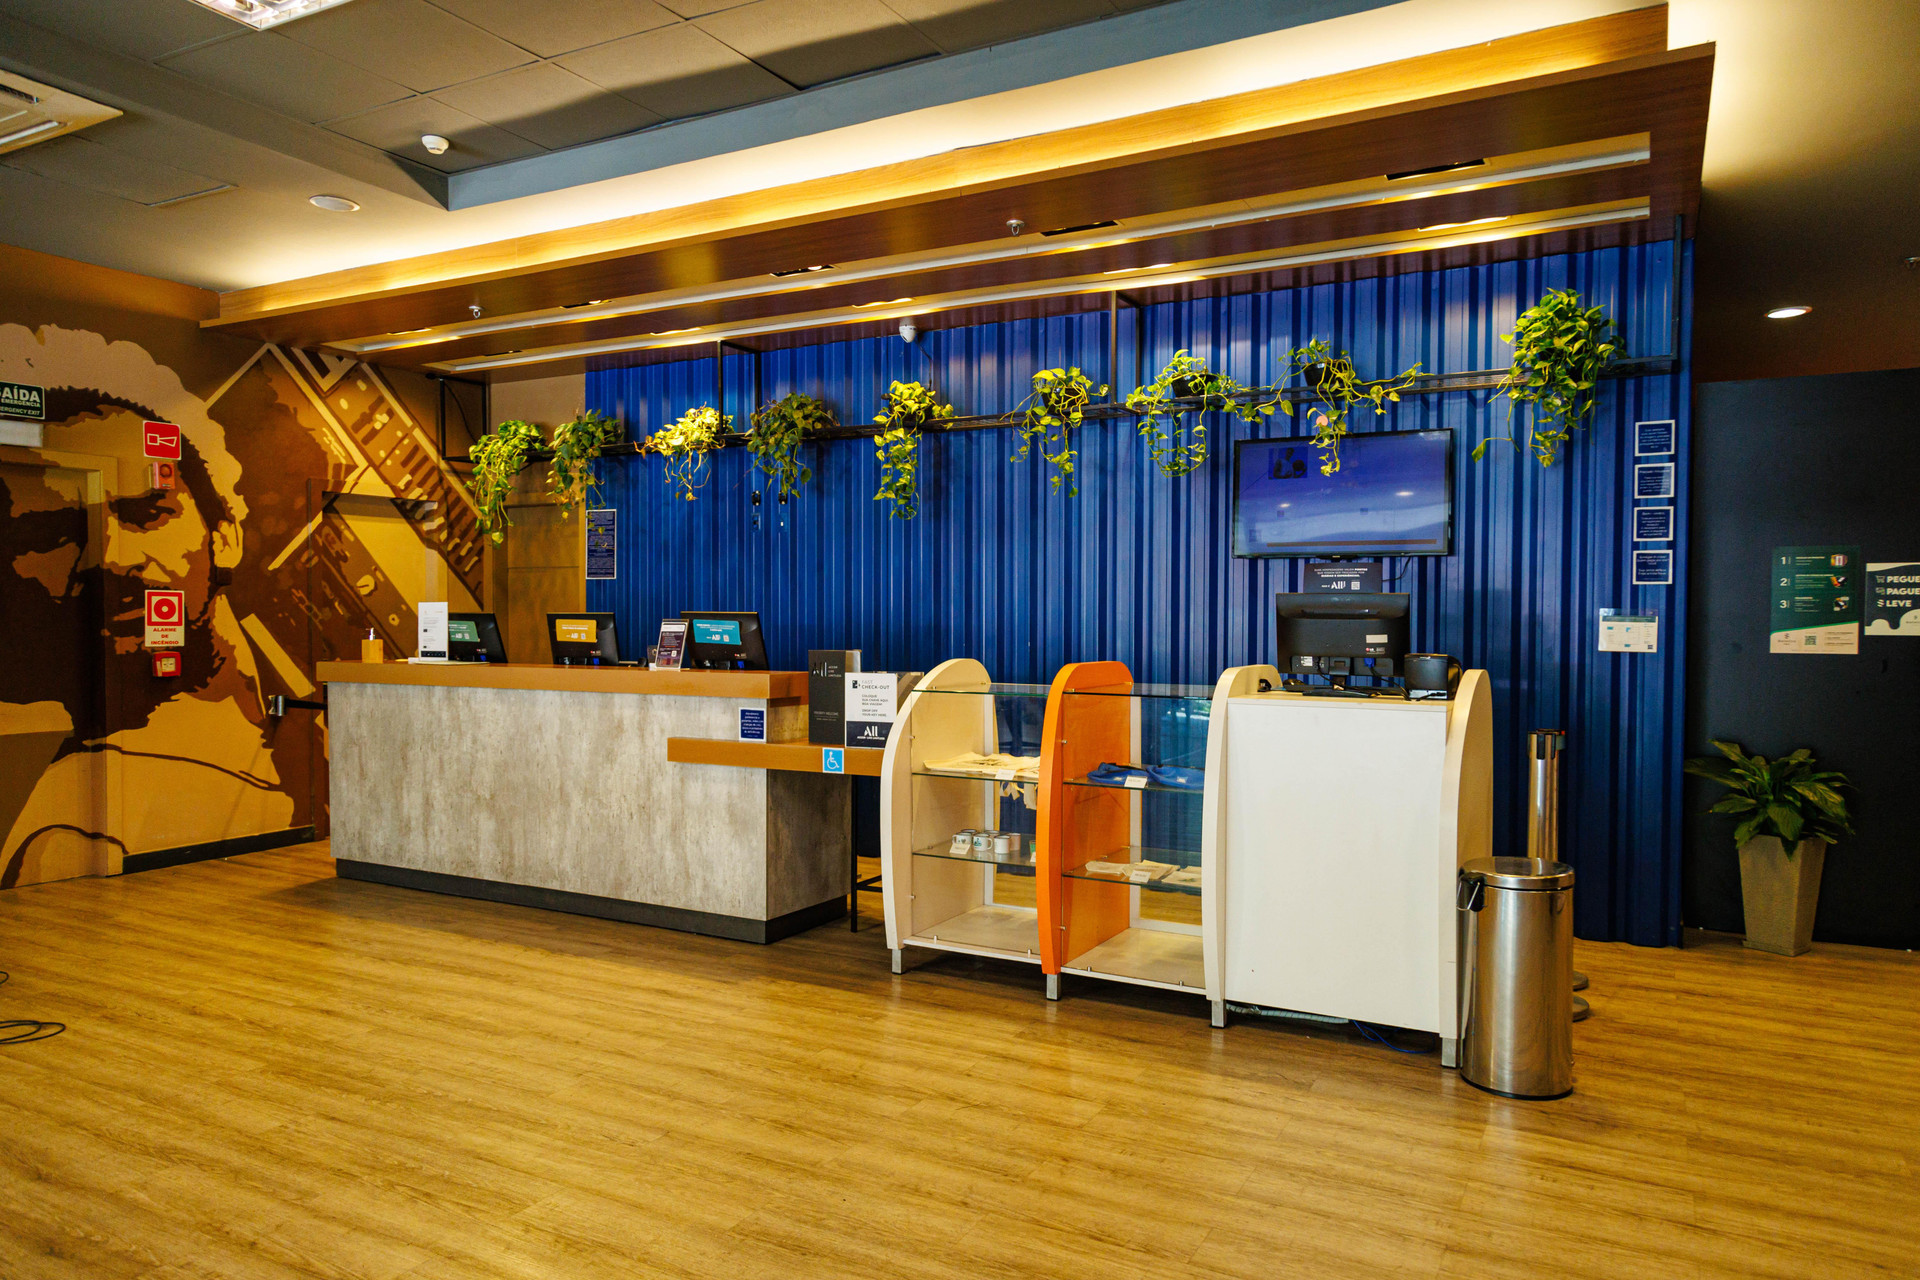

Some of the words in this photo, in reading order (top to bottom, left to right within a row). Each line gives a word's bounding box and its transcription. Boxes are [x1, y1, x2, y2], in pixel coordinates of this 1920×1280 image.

[0, 386, 41, 403] AÍDA
[1780, 556, 1786, 565] 1
[1780, 577, 1788, 586] 2
[1886, 575, 1920, 583] PEGUE
[1886, 587, 1920, 595] PAGUE
[1779, 600, 1787, 609] 3
[1886, 599, 1912, 607] LEVE
[864, 725, 878, 737] All
